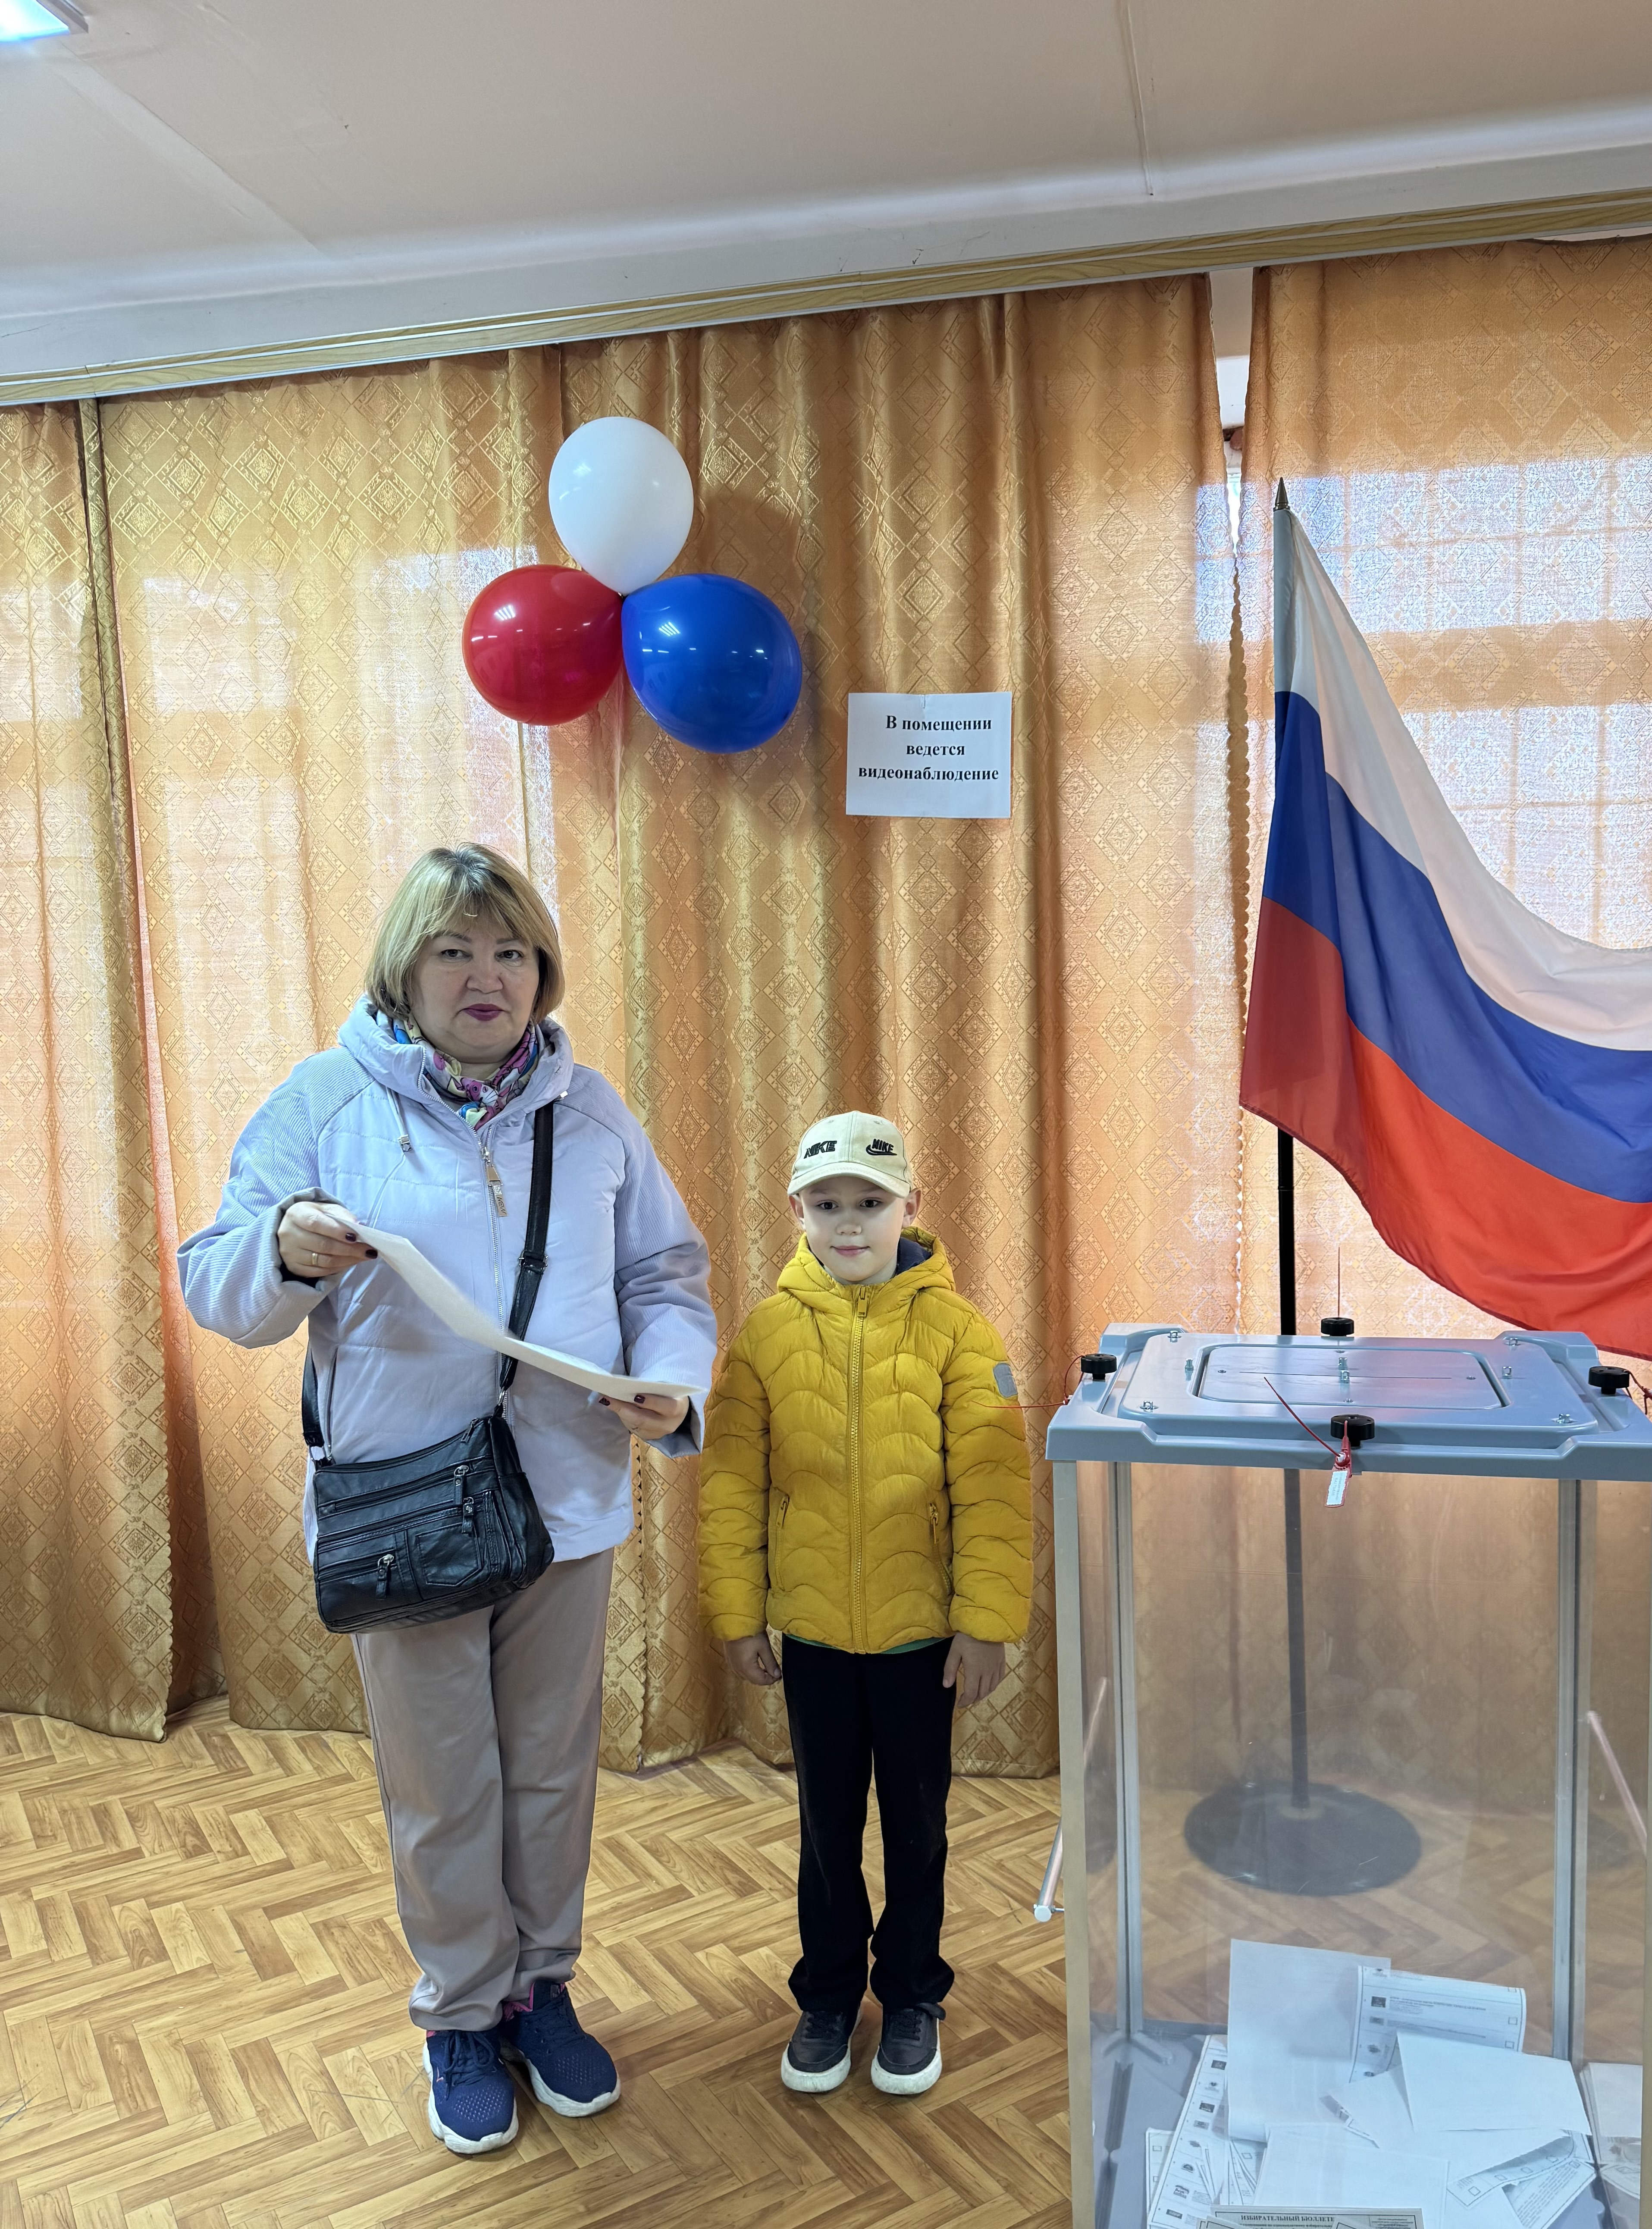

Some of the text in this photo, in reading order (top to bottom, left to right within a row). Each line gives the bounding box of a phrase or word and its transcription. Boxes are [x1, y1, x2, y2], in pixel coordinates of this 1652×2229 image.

[886, 715, 992, 732] В помещении
[906, 745, 965, 757] ведется
[859, 767, 999, 781] видеонаблюдение
[803, 1140, 837, 1159] NIKE
[871, 1138, 894, 1153] NIKE
